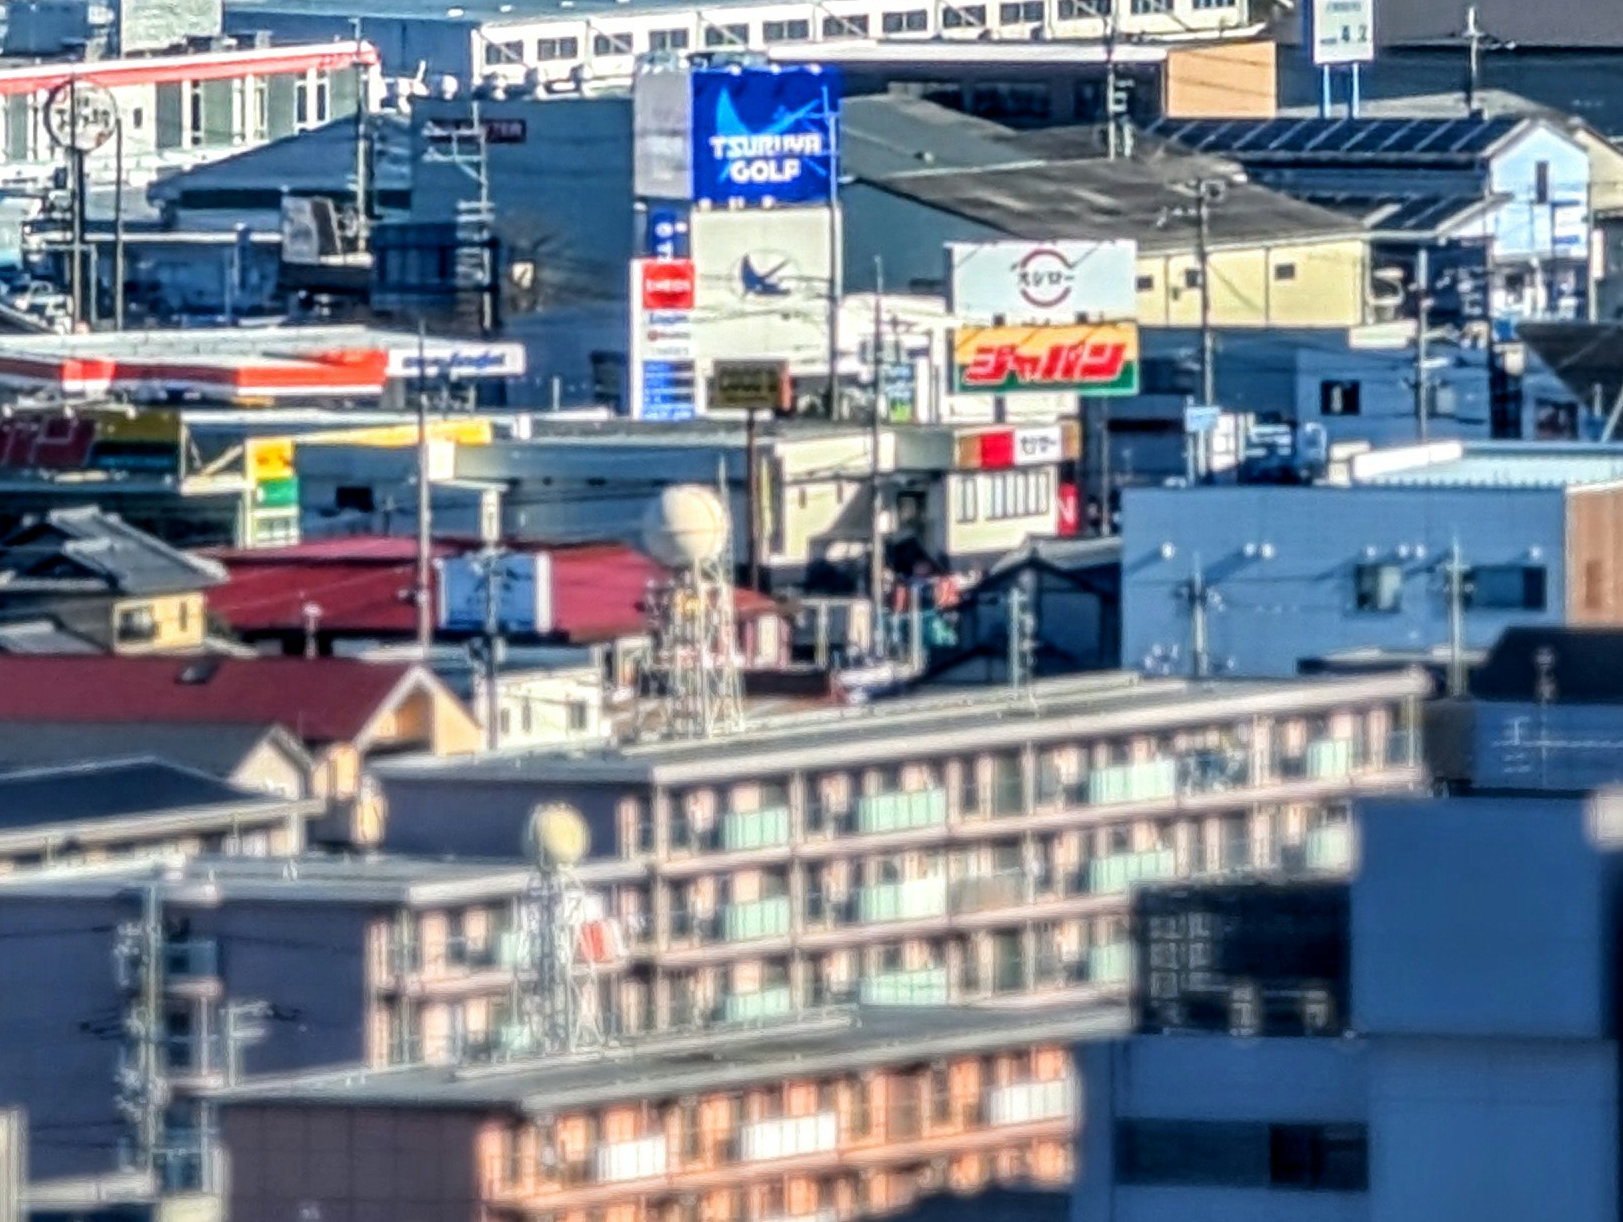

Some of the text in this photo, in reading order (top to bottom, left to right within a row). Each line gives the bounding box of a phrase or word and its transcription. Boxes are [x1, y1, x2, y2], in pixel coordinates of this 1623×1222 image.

[708, 132, 822, 159] TSURUYA
[730, 158, 801, 183] GOLF
[963, 341, 1127, 386] ジャパン
